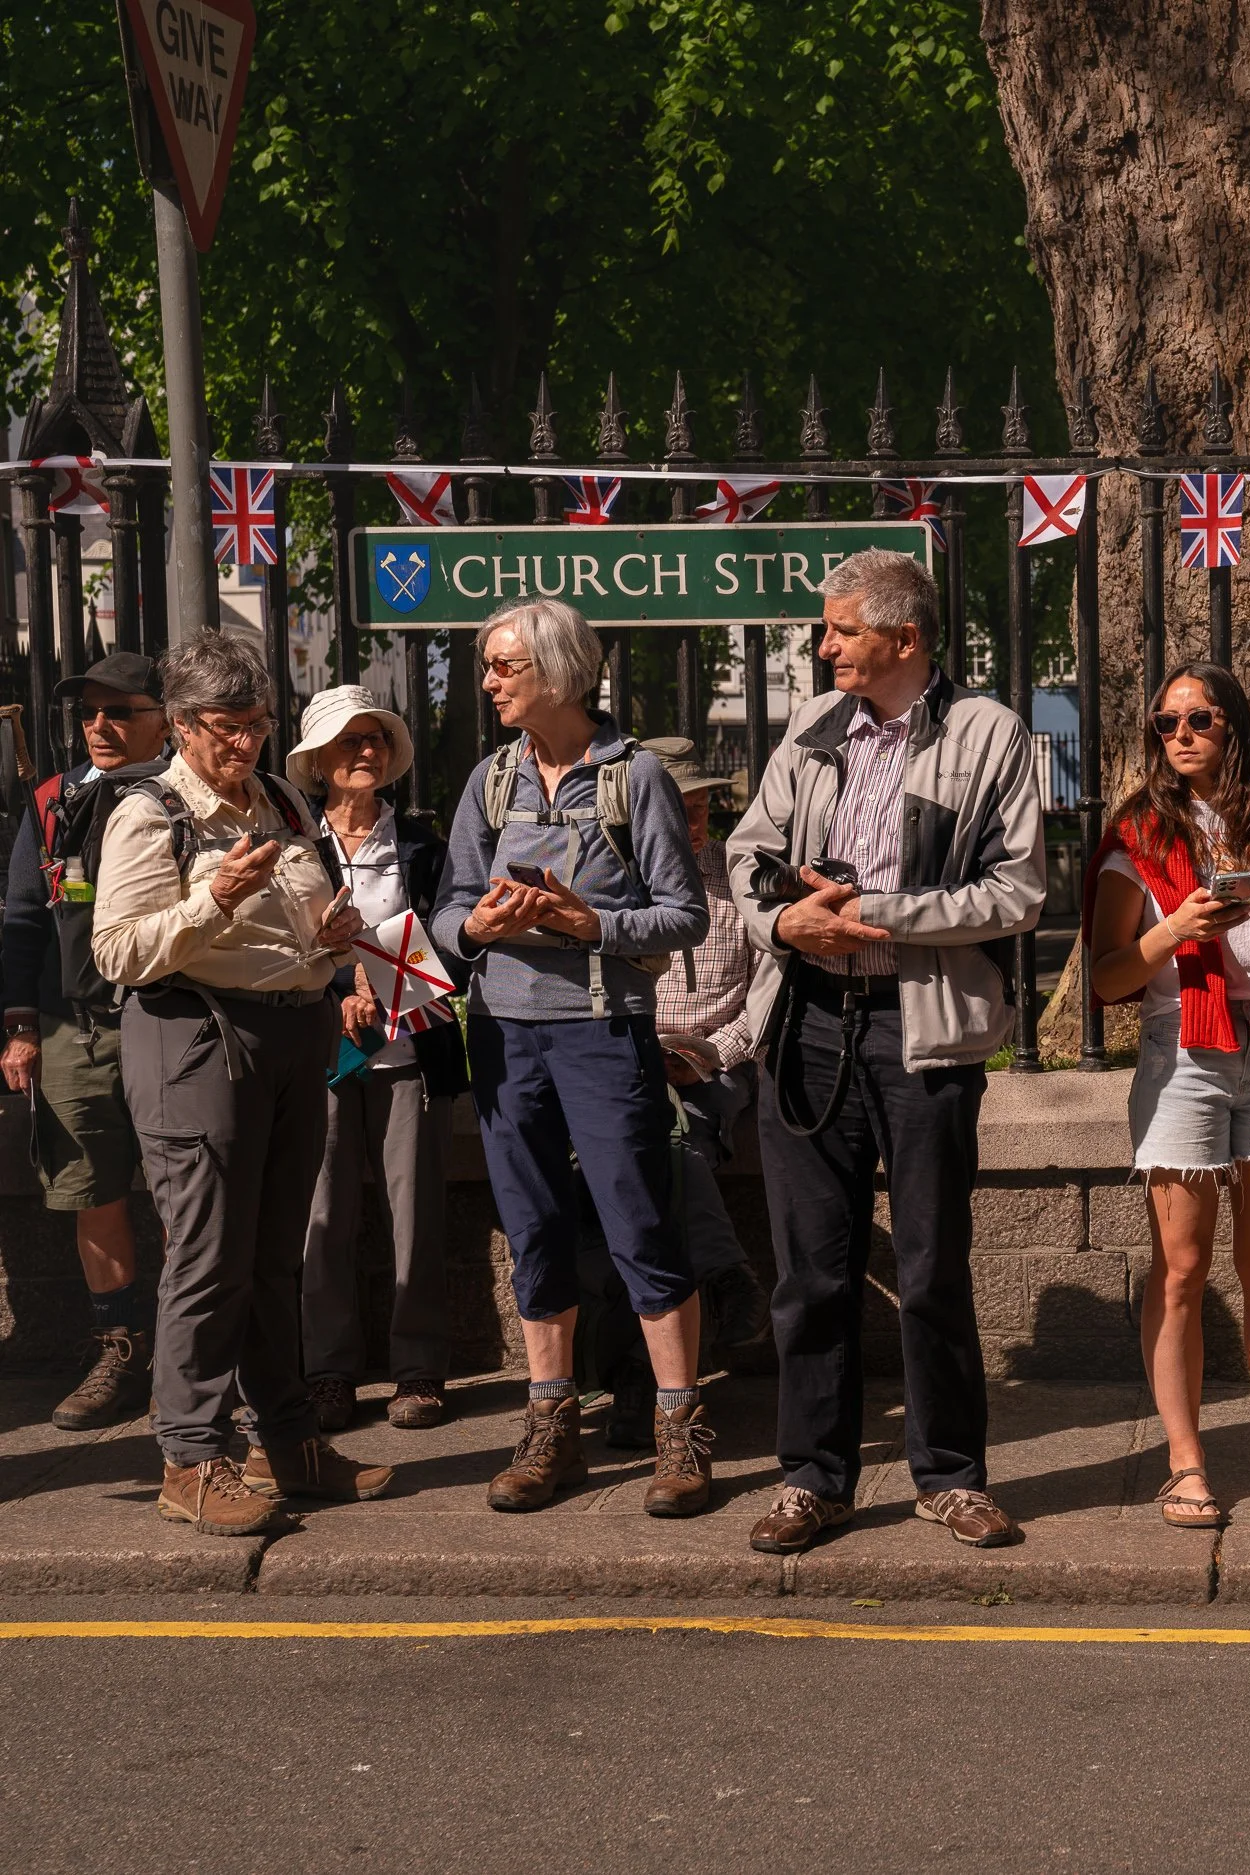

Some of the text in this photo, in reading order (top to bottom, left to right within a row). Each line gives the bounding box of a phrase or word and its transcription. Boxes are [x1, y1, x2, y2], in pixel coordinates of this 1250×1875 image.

[156, 1, 228, 80] GIVE
[169, 72, 222, 135] WAY
[452, 551, 915, 598] CHURCH STRE
[943, 770, 971, 778] Columbi
